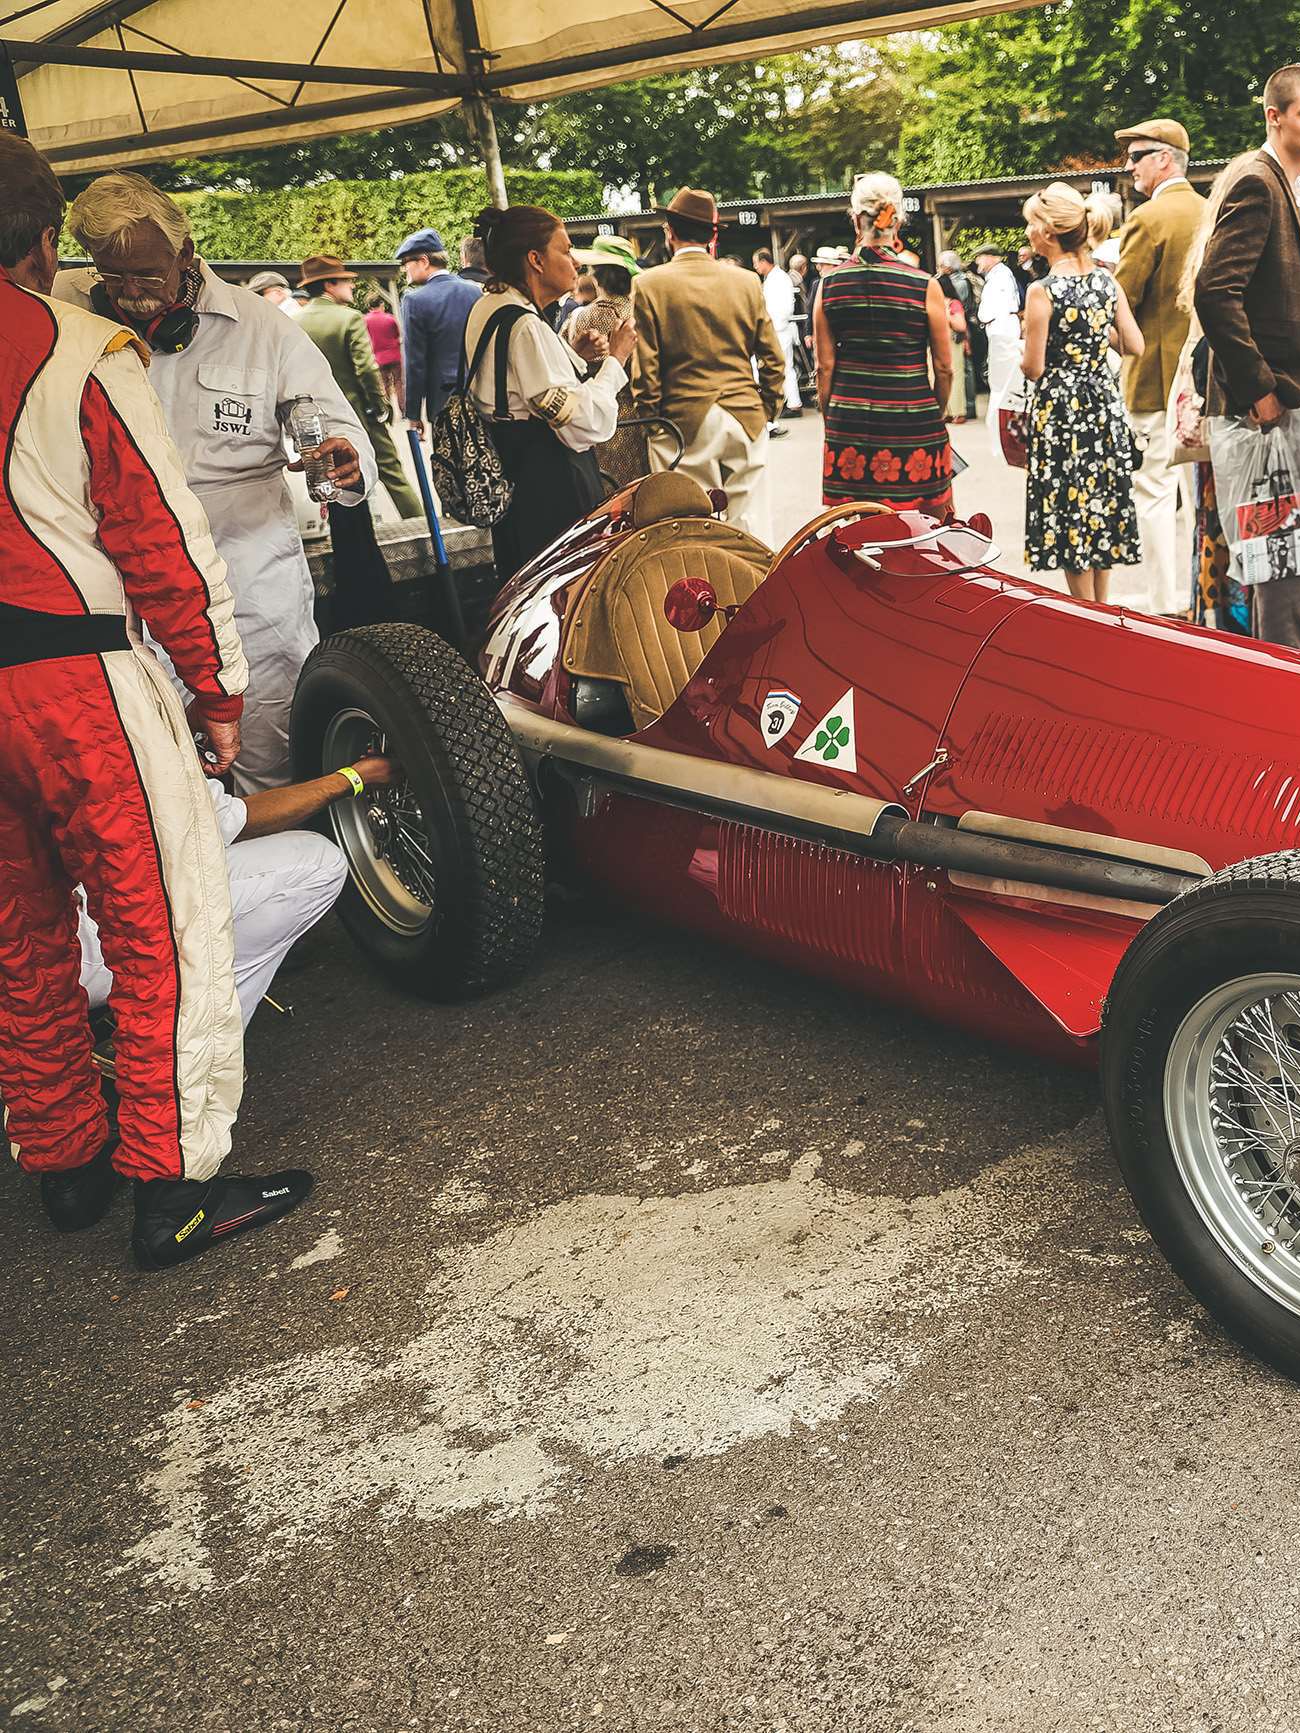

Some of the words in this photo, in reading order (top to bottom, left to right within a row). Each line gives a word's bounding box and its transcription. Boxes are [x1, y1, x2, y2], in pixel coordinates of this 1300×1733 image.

[212, 420, 251, 436] JSWL
[772, 717, 783, 731] 31
[262, 1186, 291, 1199] Sabelt
[178, 1213, 203, 1240] Sabelt
